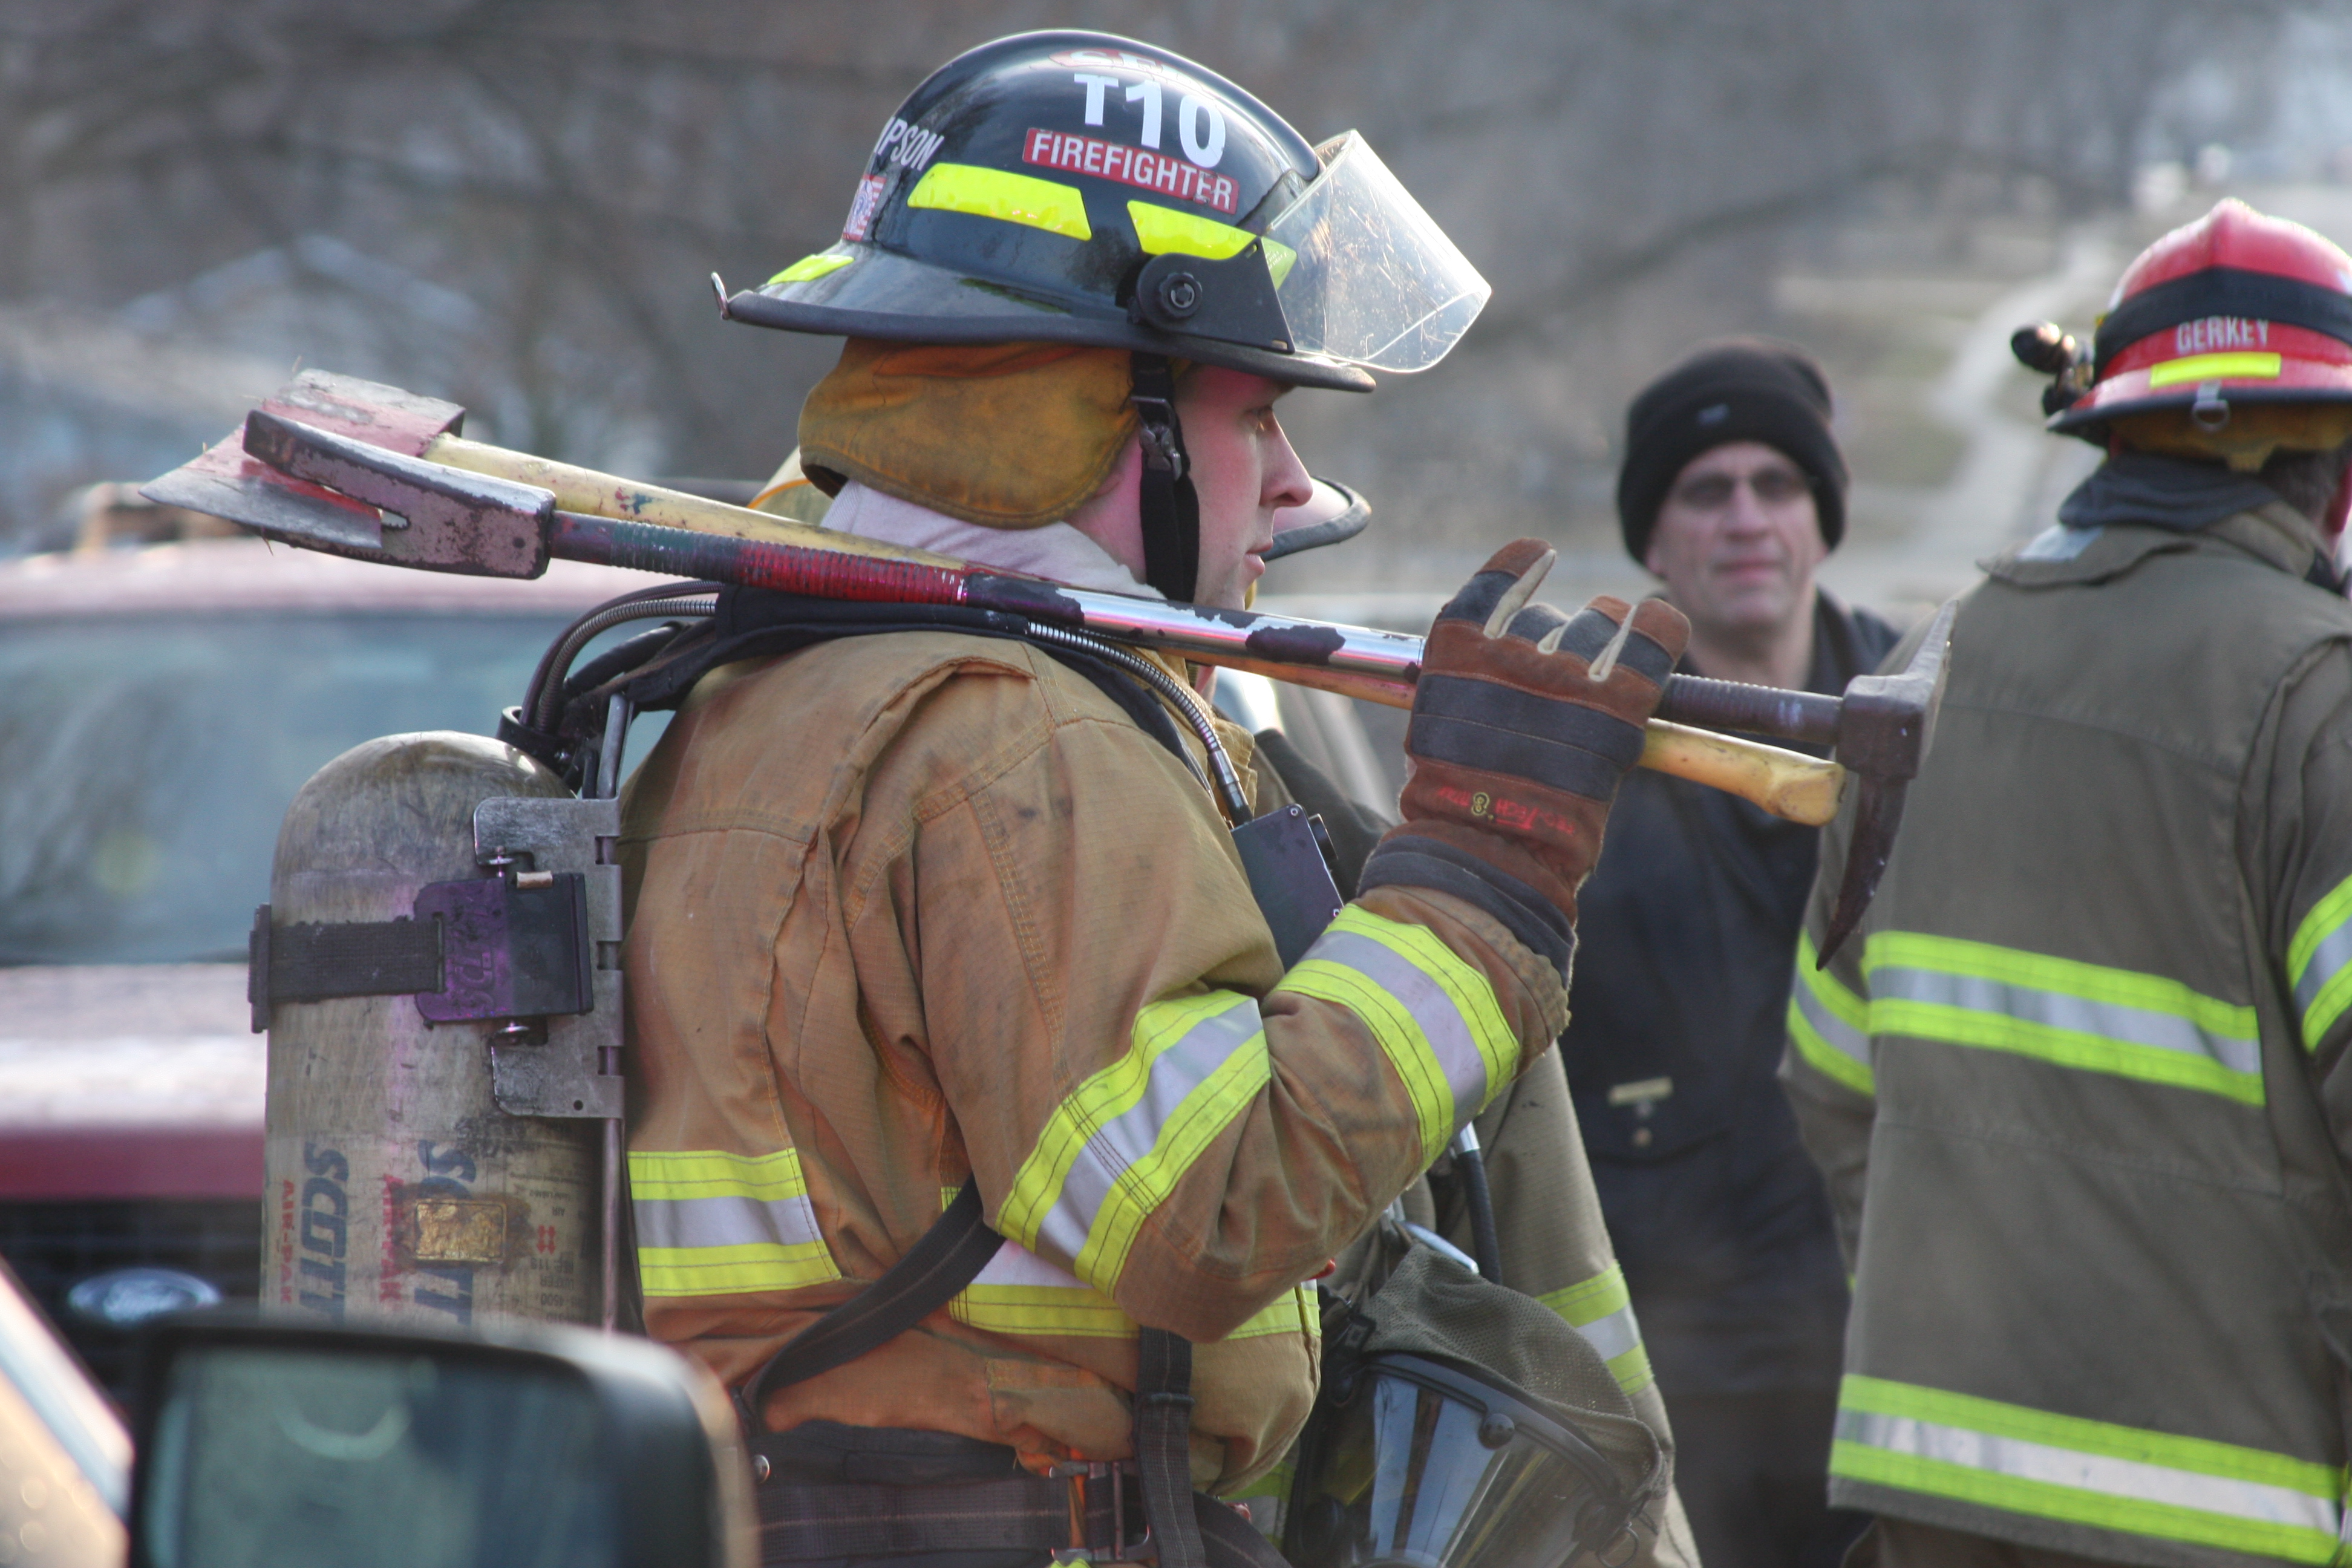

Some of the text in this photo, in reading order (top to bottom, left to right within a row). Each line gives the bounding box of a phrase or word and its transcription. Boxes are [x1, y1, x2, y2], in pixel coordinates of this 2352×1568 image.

[875, 116, 945, 172] PSON
[1073, 72, 1227, 168] T10
[1031, 132, 1234, 211] FIREFIGHTER
[2177, 315, 2269, 353] GERKEY
[280, 1179, 295, 1305] AIR-PAK
[298, 1142, 350, 1326] SCOTT
